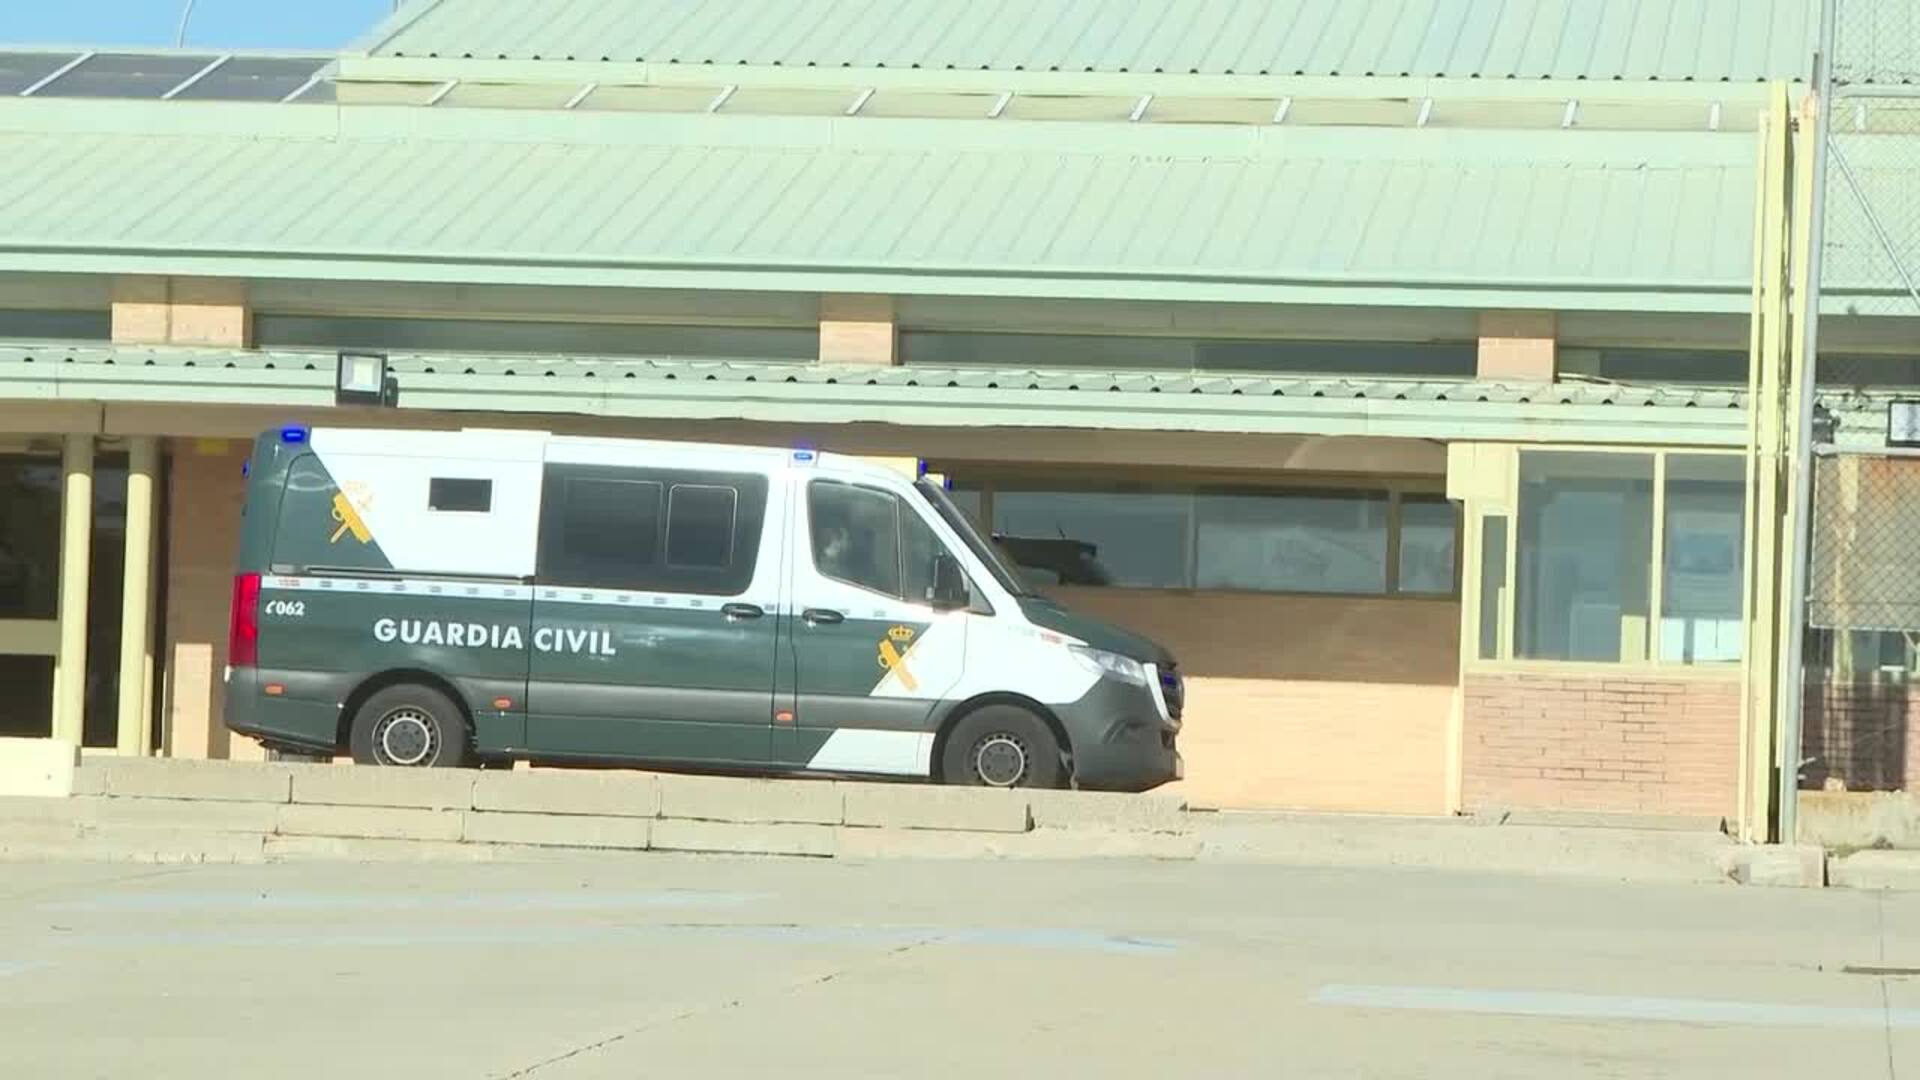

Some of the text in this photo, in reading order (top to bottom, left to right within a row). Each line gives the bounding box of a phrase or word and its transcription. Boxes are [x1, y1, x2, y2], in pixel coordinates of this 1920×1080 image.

[275, 601, 305, 617] 062
[373, 618, 616, 656] GUARDIA CIVIL
